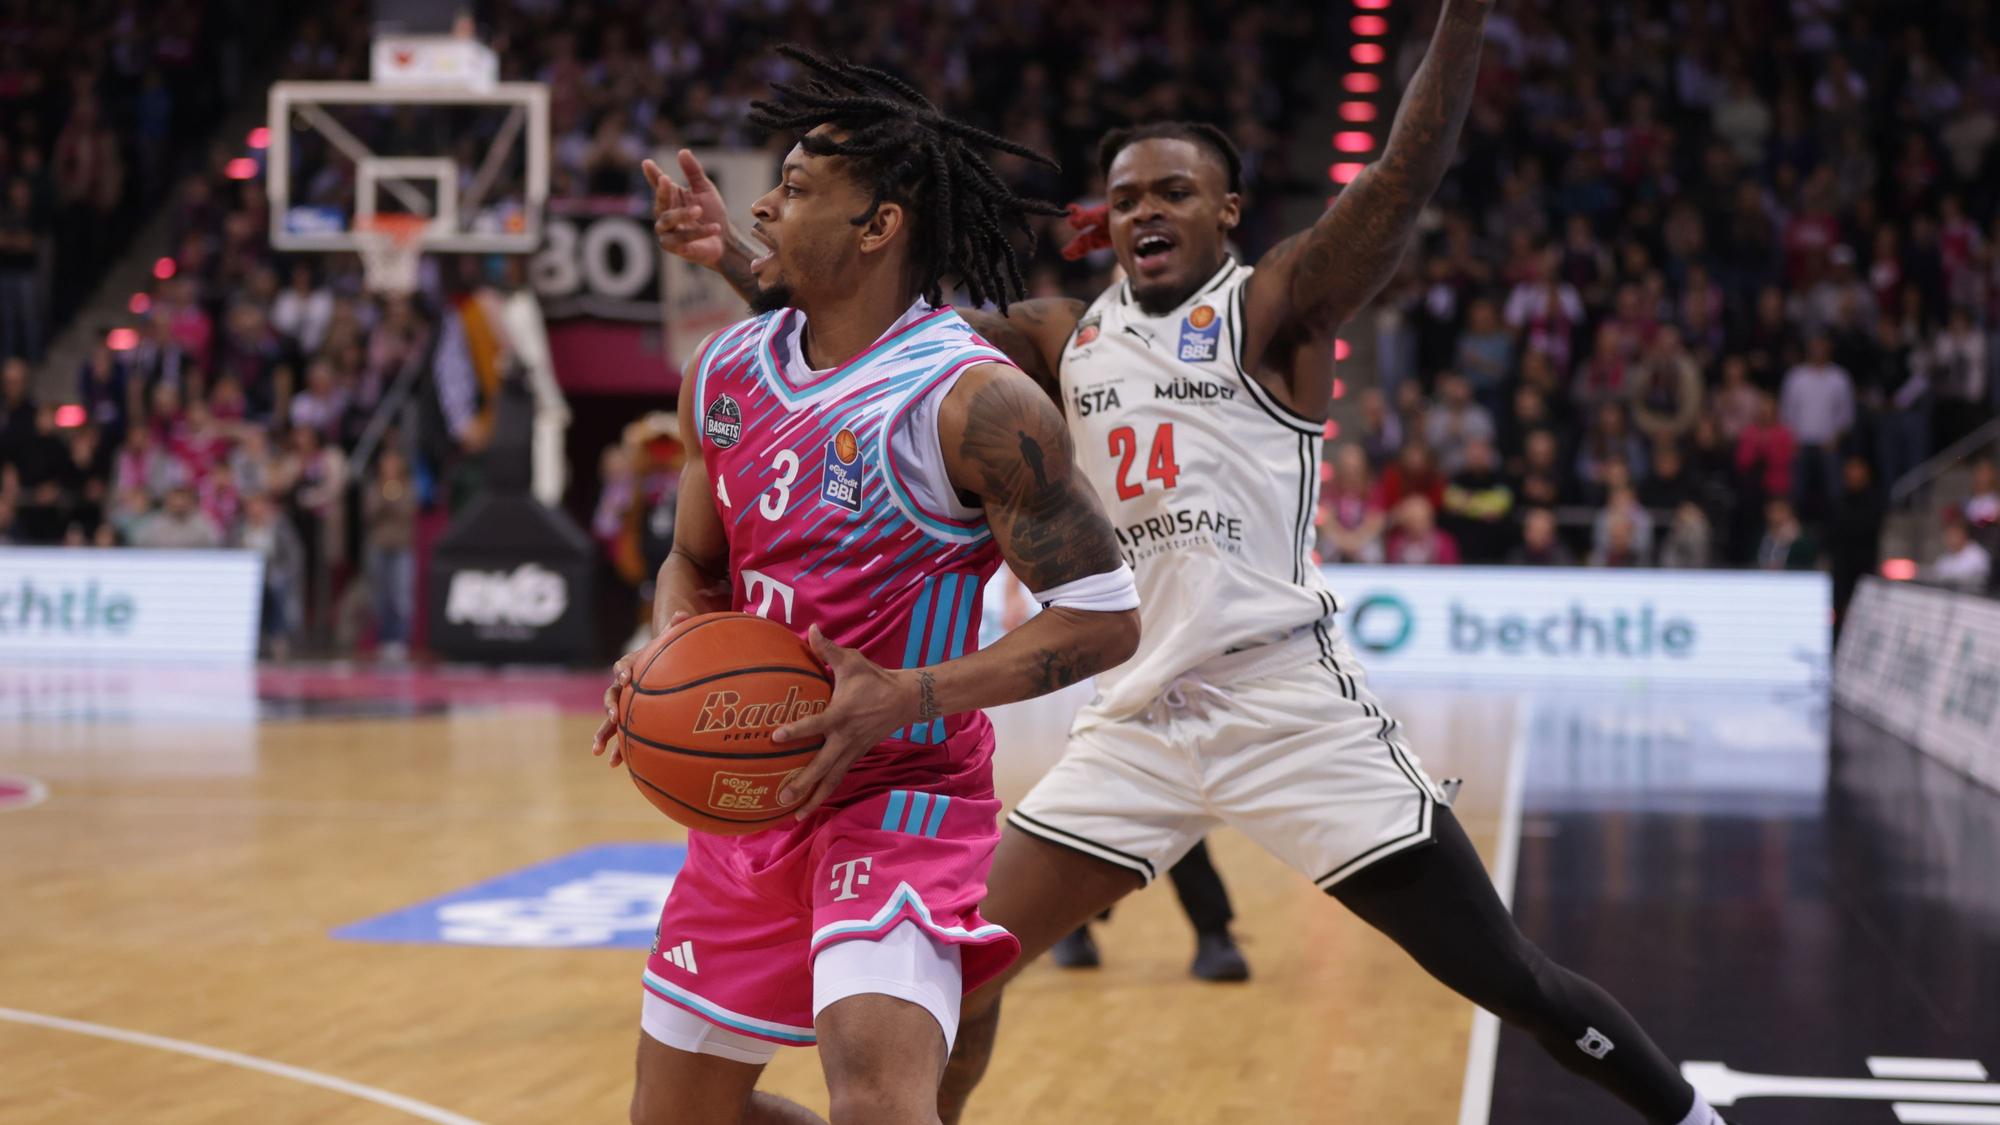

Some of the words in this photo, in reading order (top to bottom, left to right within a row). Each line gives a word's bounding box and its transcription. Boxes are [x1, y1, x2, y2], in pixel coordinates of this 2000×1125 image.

[708, 419, 739, 439] BASKETS
[759, 449, 800, 522] 3
[1108, 422, 1180, 502] 24
[826, 480, 857, 505] BBL
[1449, 600, 1697, 656] bechtle
